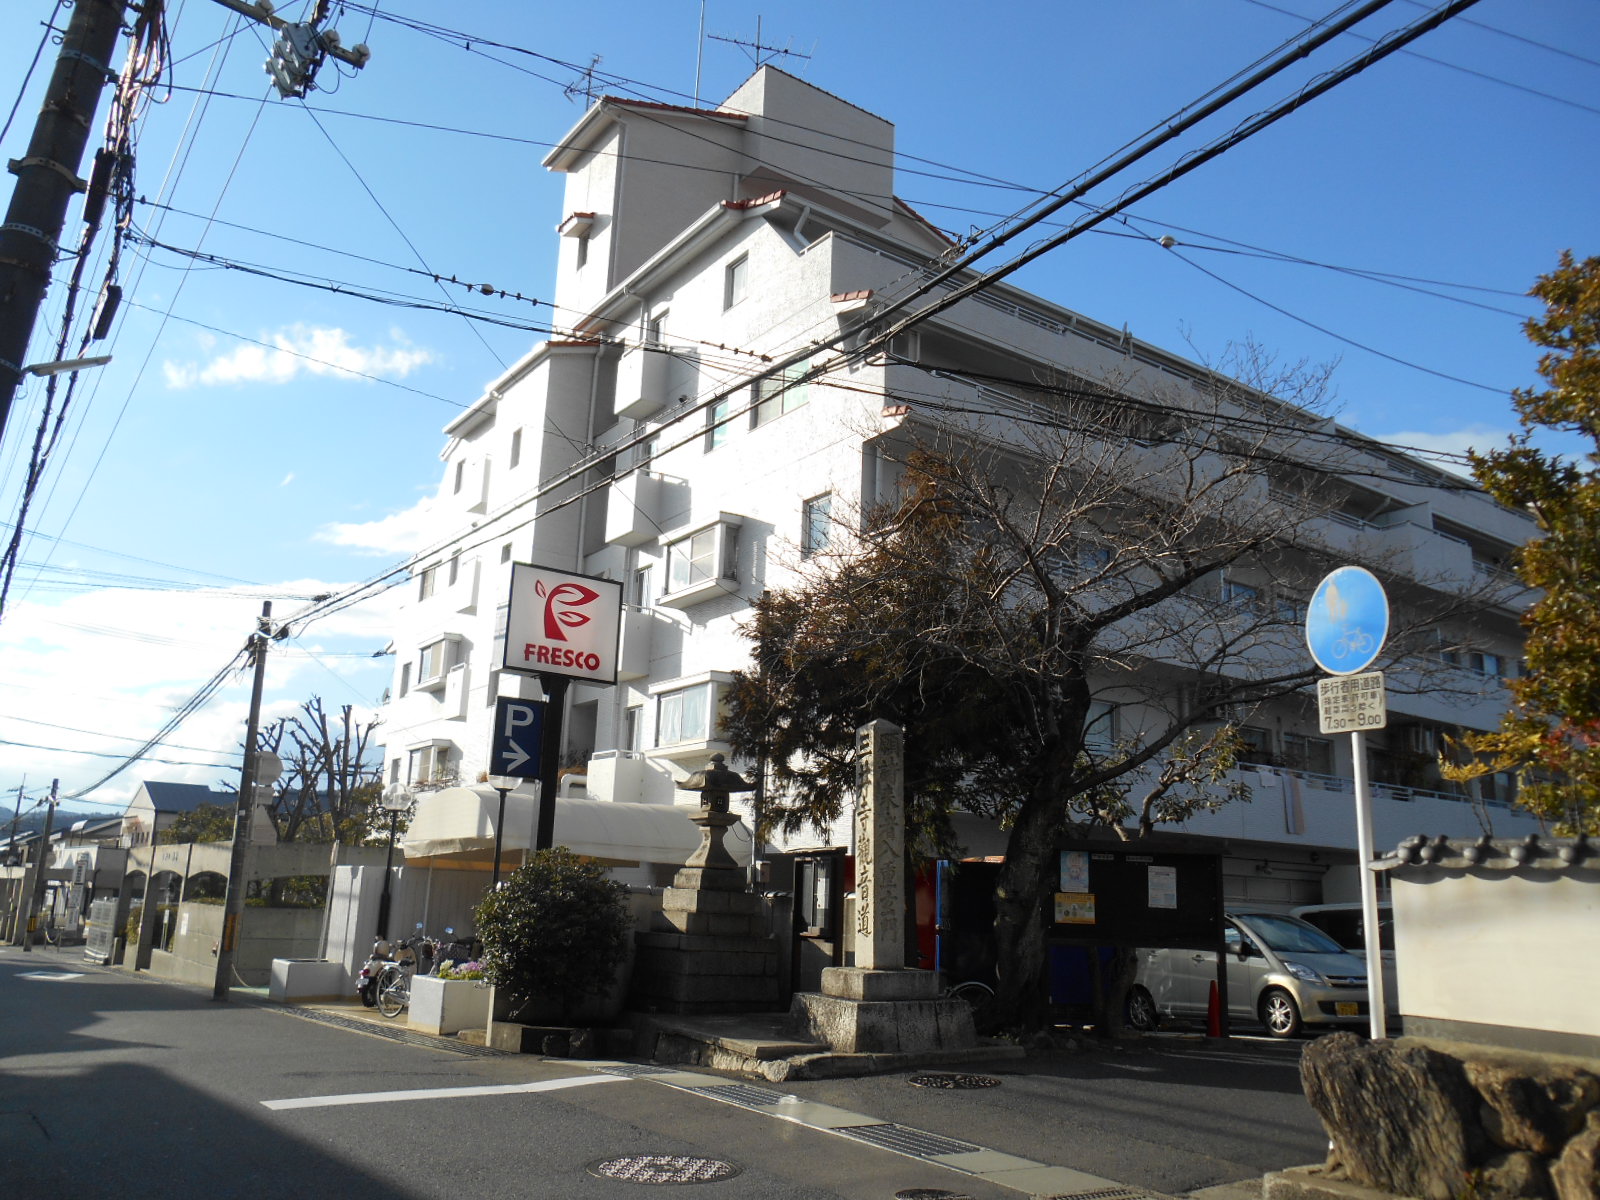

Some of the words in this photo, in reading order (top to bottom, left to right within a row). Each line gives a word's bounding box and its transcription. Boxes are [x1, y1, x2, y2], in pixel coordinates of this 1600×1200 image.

[524, 643, 601, 671] FRESCO
[1321, 676, 1381, 696] 歩行者用道路
[504, 703, 535, 737] P
